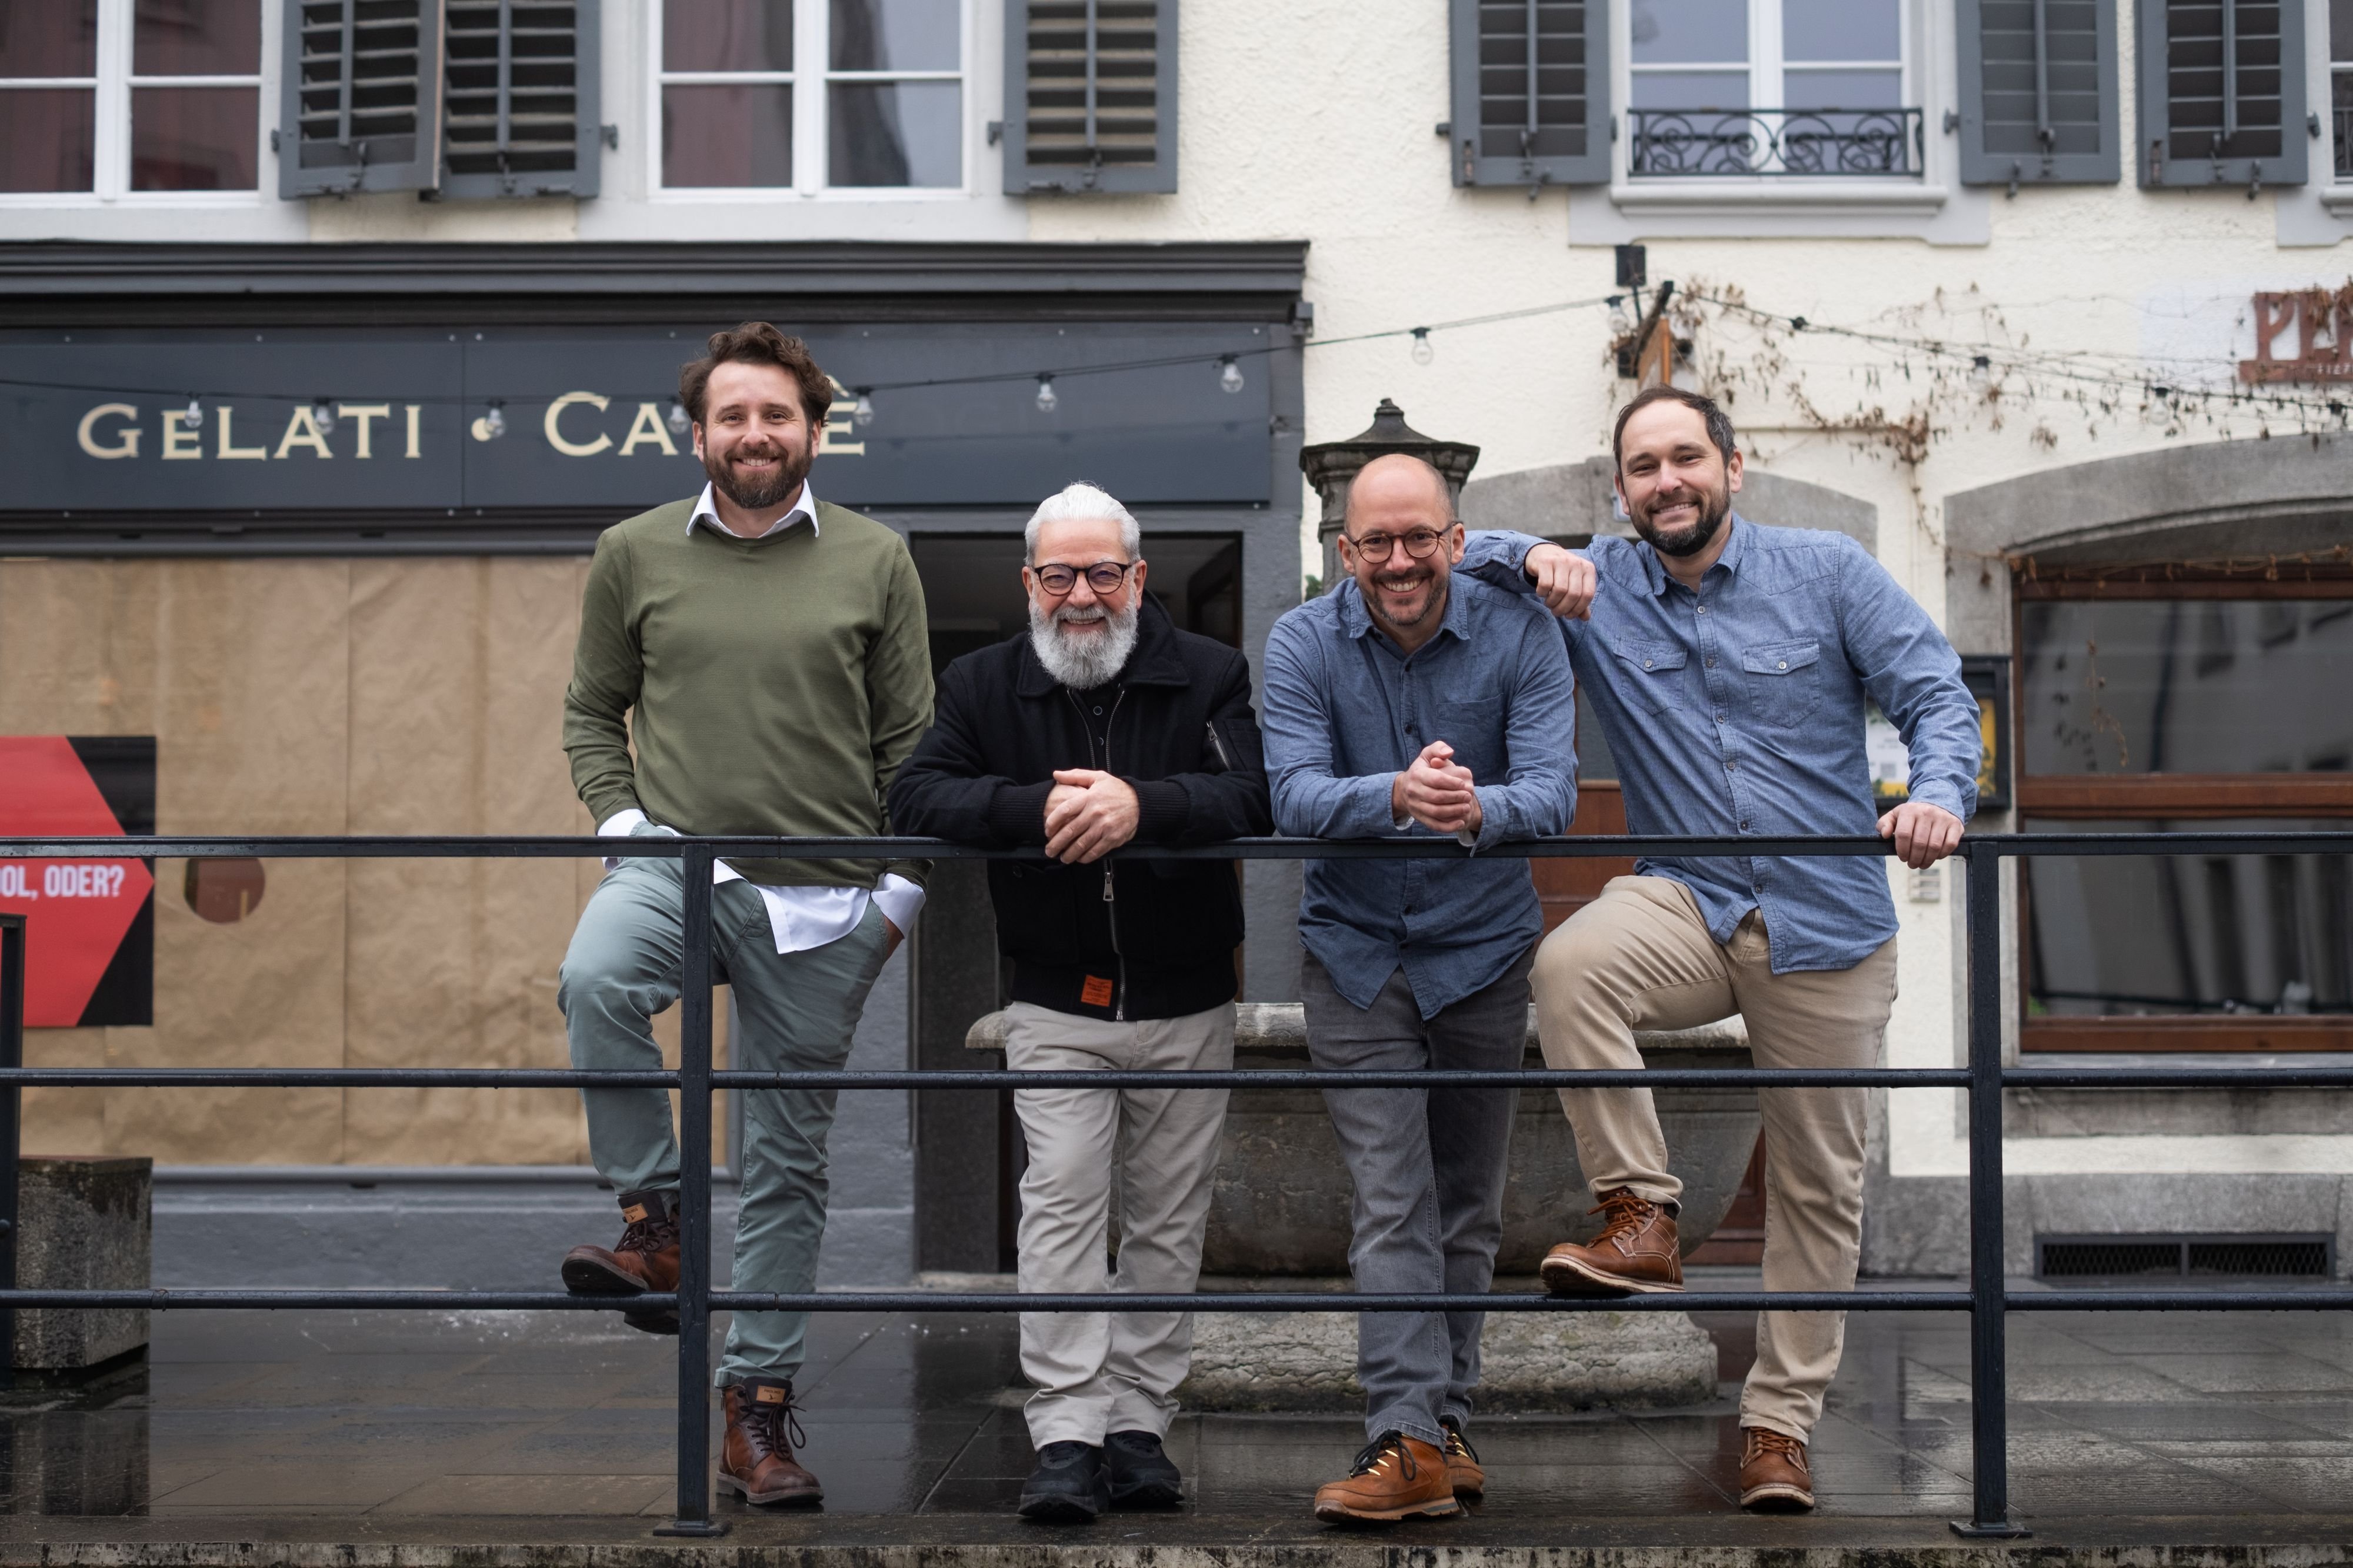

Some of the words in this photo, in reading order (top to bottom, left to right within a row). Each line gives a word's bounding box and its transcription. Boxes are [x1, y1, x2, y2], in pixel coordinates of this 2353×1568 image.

[77, 403, 422, 461] GELATI
[0, 865, 38, 901] OL,
[44, 865, 125, 898] ODER?
